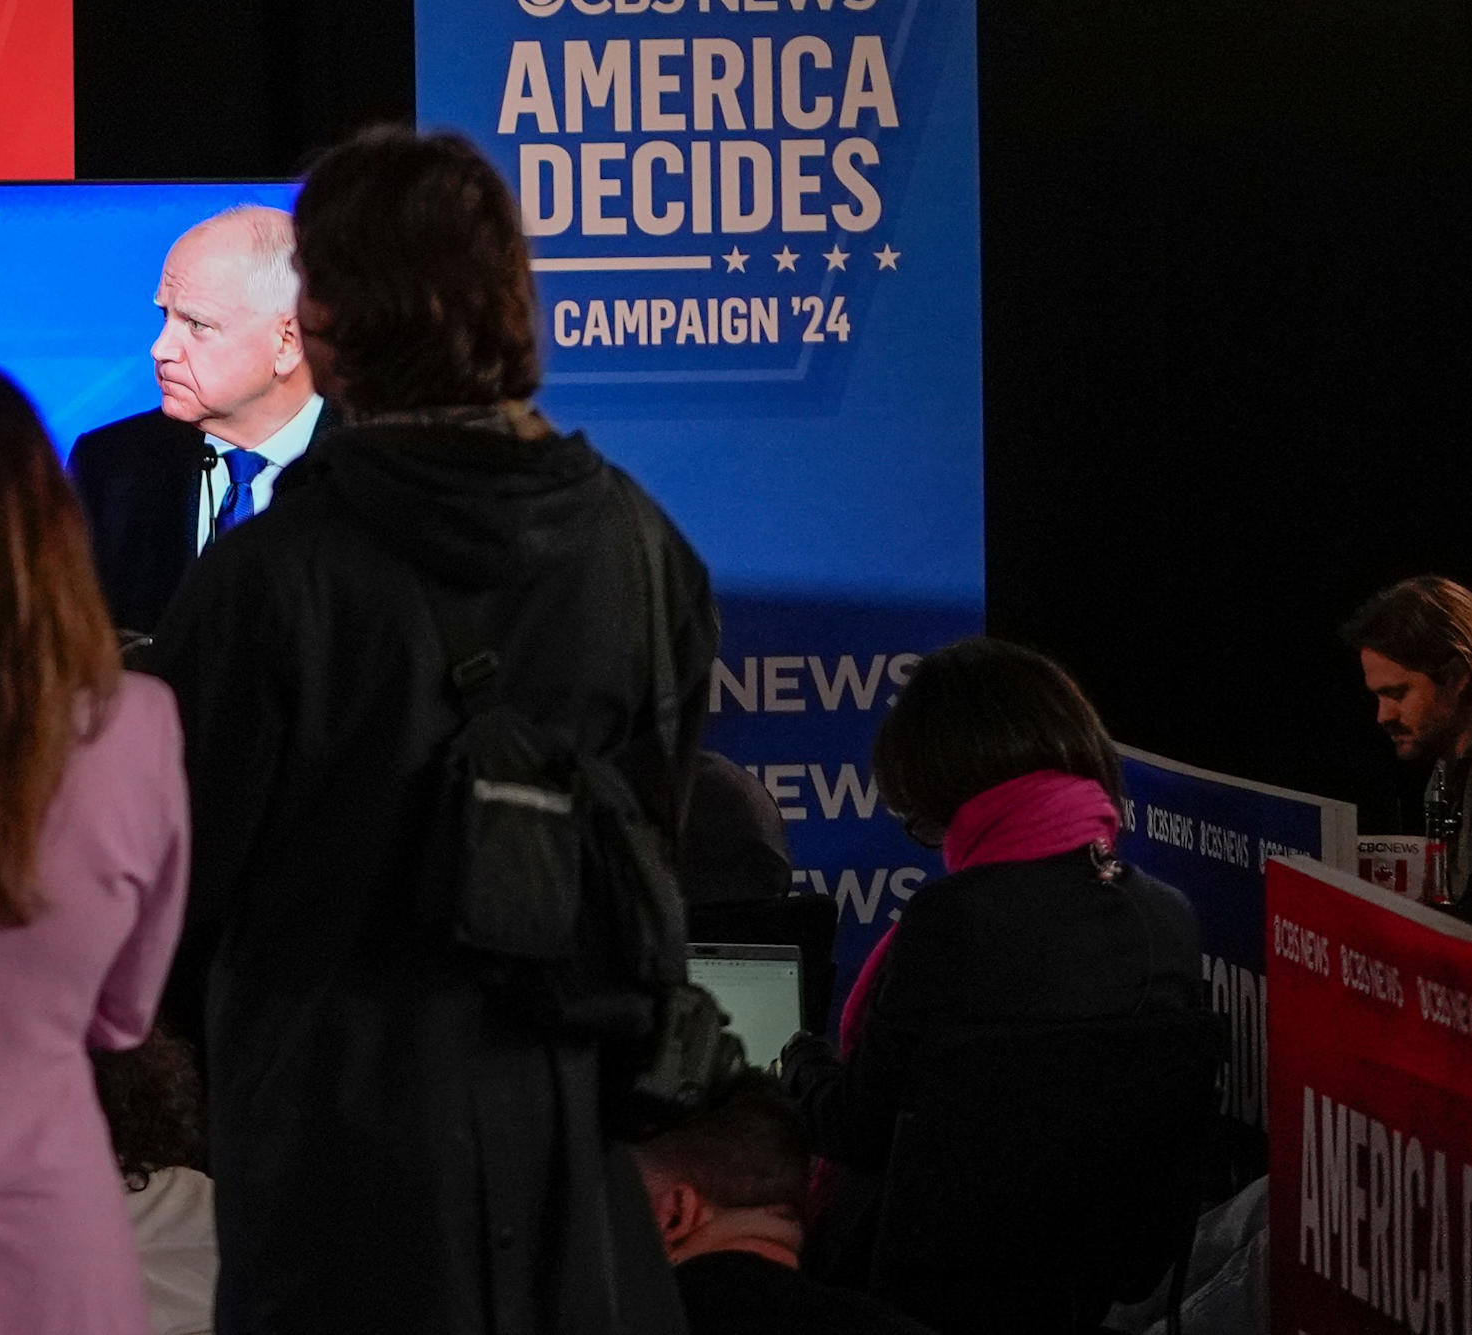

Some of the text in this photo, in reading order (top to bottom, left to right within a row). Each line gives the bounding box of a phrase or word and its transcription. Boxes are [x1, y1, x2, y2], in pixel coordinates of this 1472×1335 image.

[496, 35, 900, 135] AMERICA
[518, 137, 882, 237] DECIDES
[553, 295, 851, 347] CAMPAIGN '24
[1298, 1085, 1453, 1335] AMERICA
